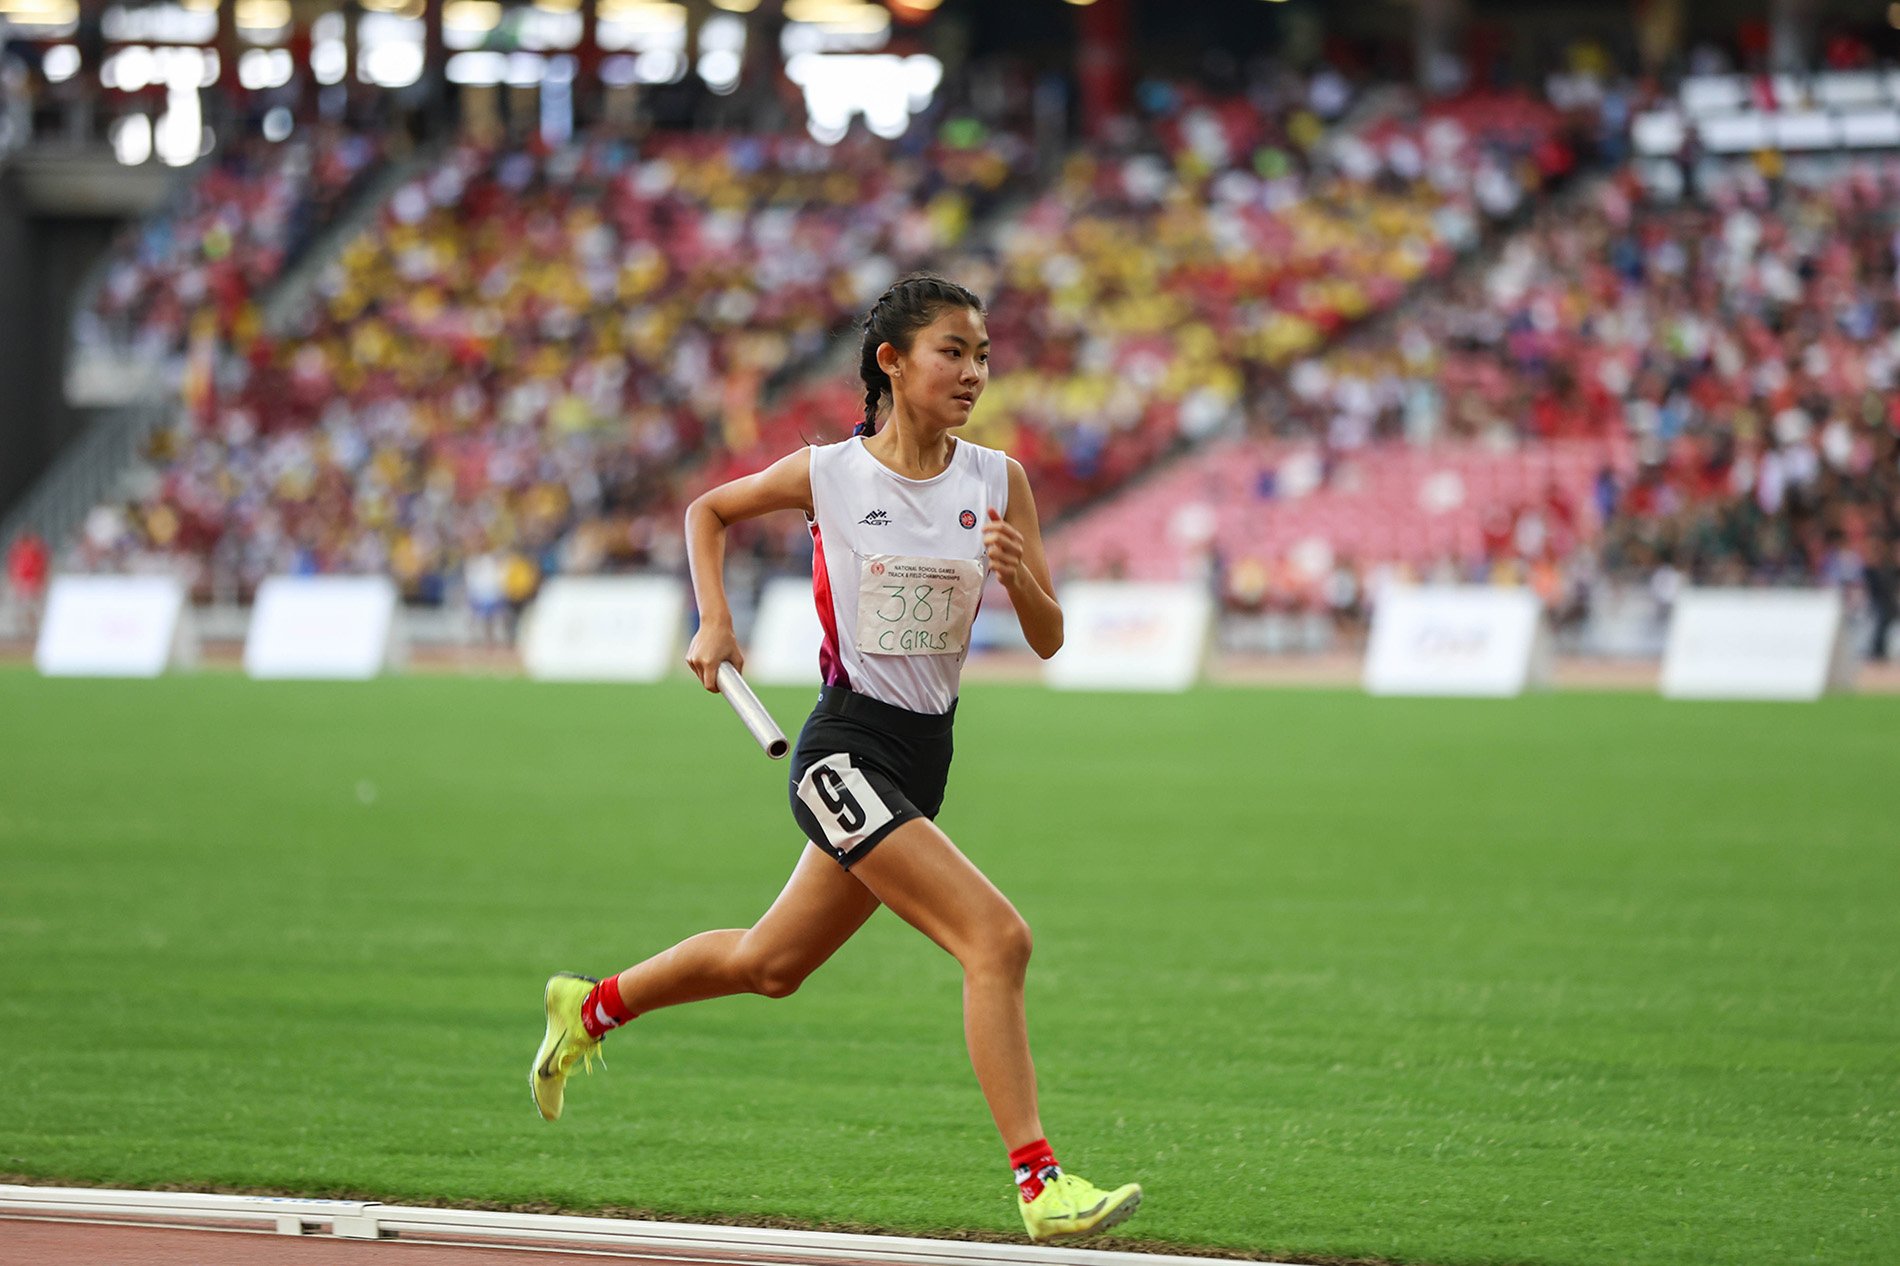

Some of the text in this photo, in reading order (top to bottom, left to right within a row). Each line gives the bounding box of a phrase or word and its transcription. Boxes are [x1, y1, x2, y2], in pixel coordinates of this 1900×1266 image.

[922, 573, 960, 581] CHAMPIONSHIPS
[877, 585, 954, 622] 381
[879, 629, 948, 651] C GIRLS
[811, 764, 866, 834] 9
